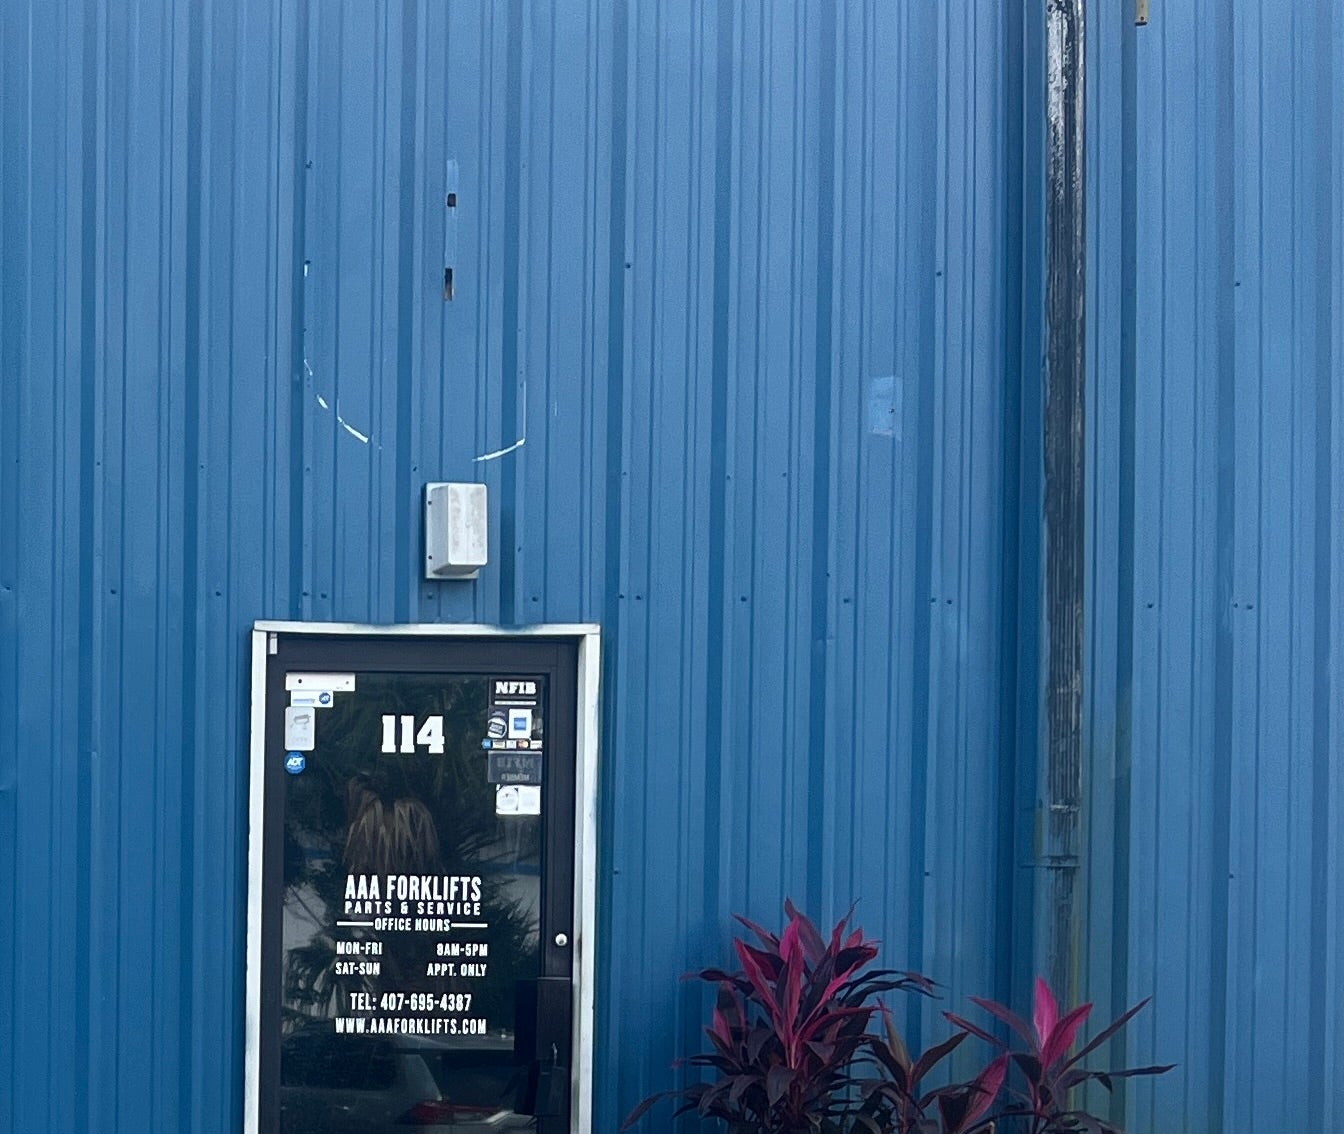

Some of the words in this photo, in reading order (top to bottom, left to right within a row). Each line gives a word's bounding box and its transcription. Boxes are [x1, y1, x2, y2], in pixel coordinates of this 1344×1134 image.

[495, 681, 537, 695] NFIB
[381, 714, 445, 754] 114
[345, 874, 380, 900] AAA
[386, 875, 482, 901] FORKLIFTS
[344, 901, 392, 914] PARTS
[400, 901, 409, 914] &
[417, 902, 481, 916] SERVICE
[374, 917, 412, 931] OFFICE
[415, 918, 451, 931] HOURS
[336, 941, 383, 955] MON-FRI
[436, 943, 488, 957] 8AM-5PM
[335, 962, 381, 975] SAT-SUN
[426, 963, 457, 976] APPT.
[460, 963, 487, 976] ONLY
[350, 992, 377, 1010] TEL:
[380, 993, 472, 1011] 407-695-4387
[335, 1017, 487, 1035] WWW.AAAFORKLIFTS.COM
